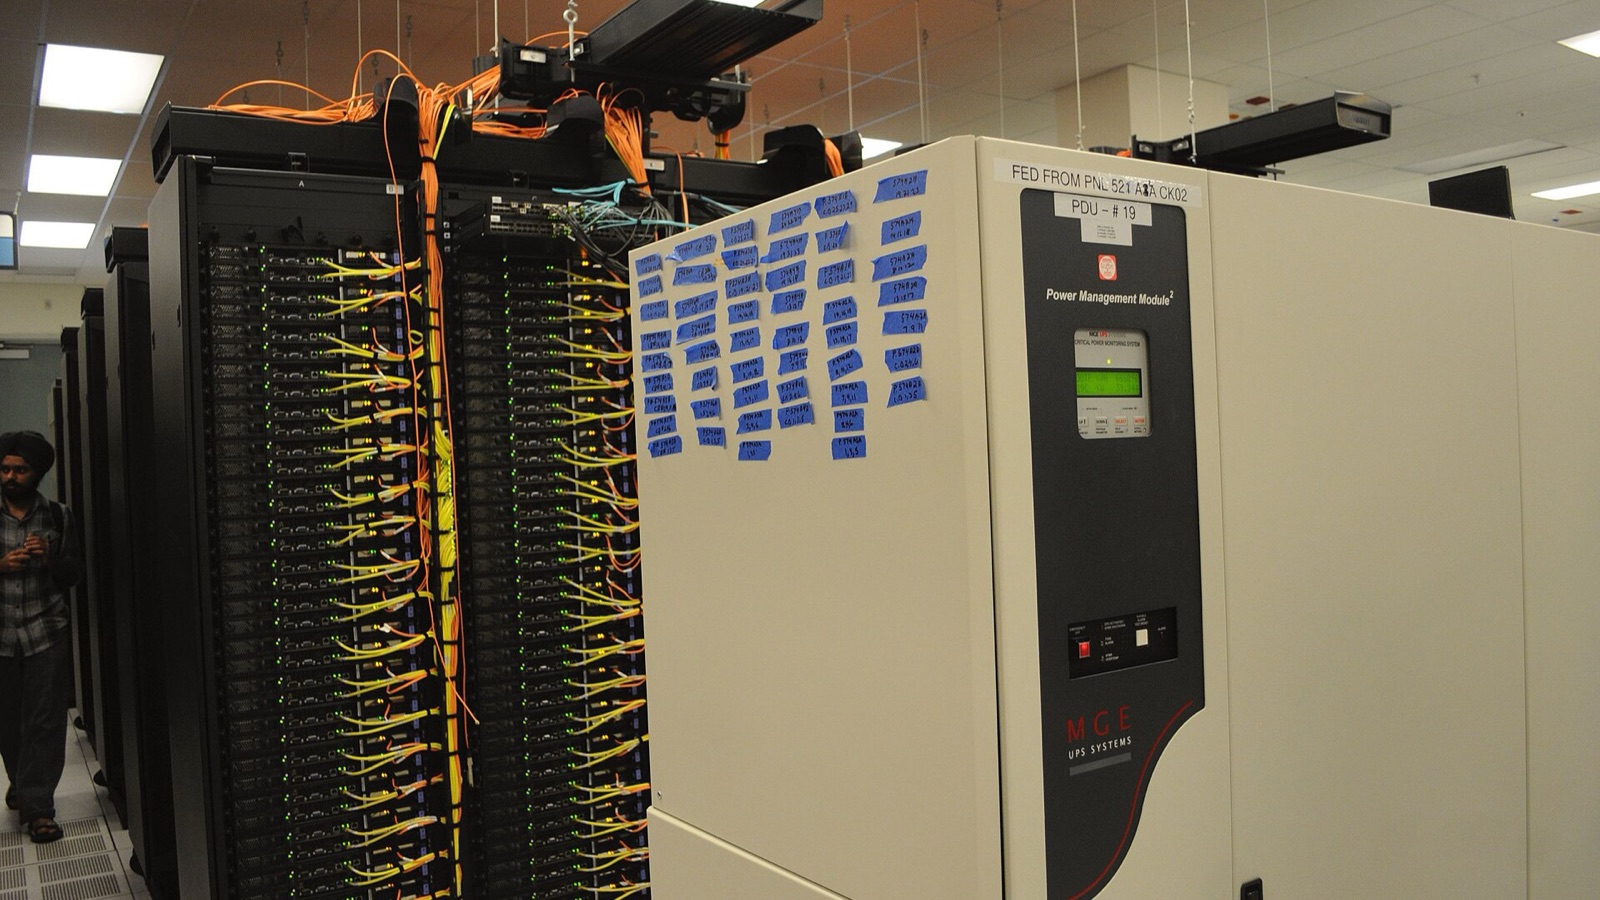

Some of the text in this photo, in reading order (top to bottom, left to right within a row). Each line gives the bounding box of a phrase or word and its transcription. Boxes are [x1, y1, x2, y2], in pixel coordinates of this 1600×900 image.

[1012, 165, 1039, 182] FED
[1043, 169, 1081, 188] FROM
[1085, 175, 1109, 192] PNL
[1111, 178, 1131, 194] 521
[1160, 185, 1187, 202] CK02
[1072, 199, 1098, 215] PDU
[1123, 206, 1136, 220] 19
[1046, 288, 1077, 302] Power
[1079, 290, 1137, 305] Management
[1068, 736, 1132, 760] UPS SYSTEMS
